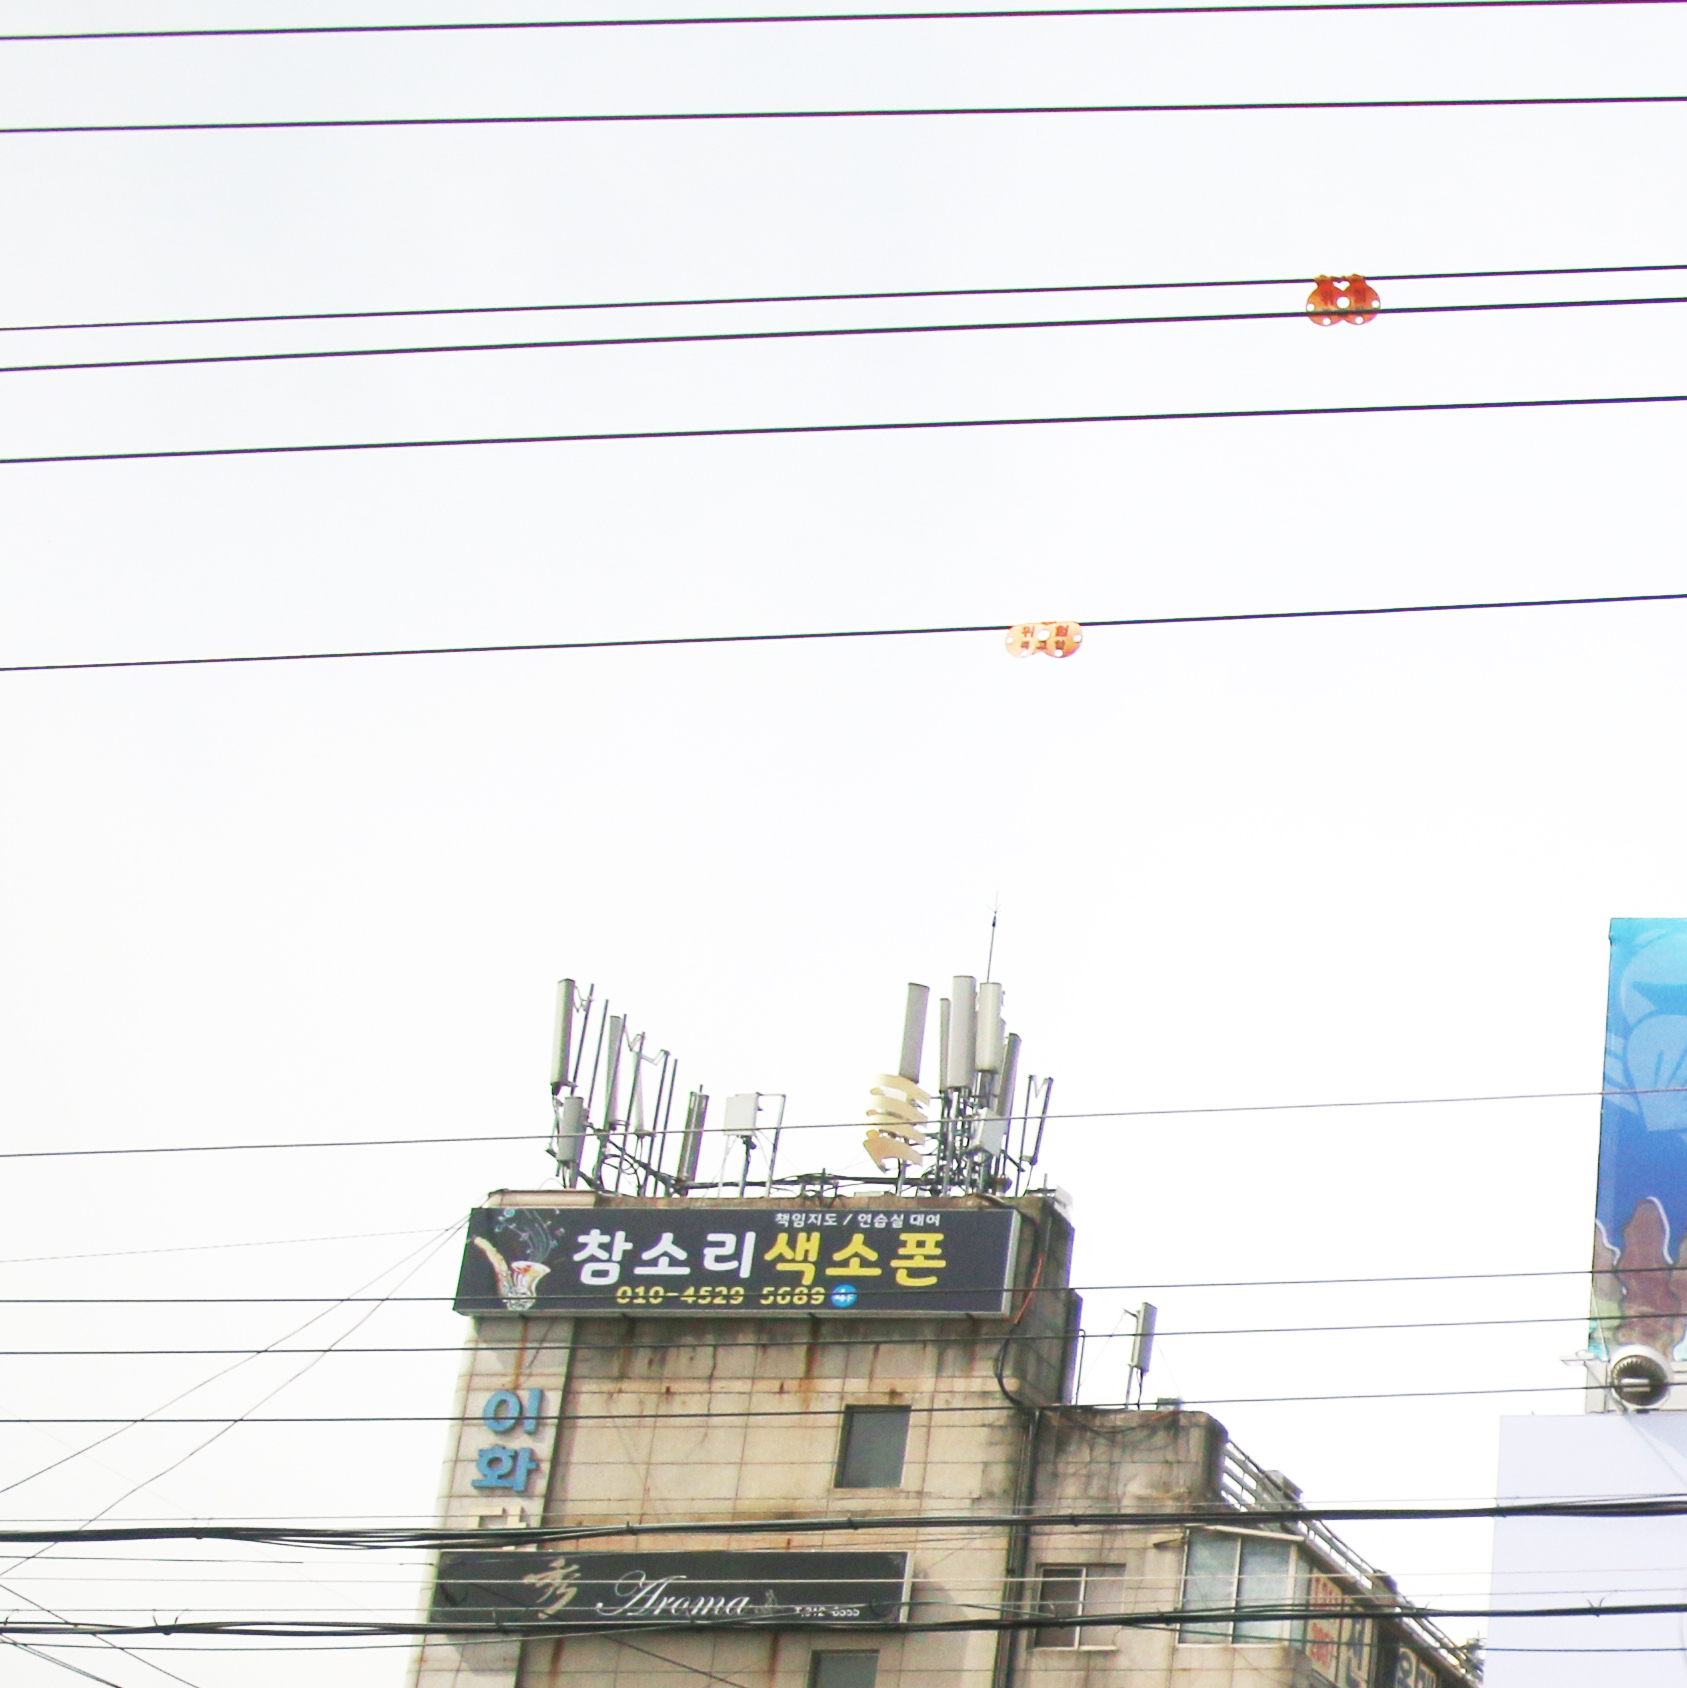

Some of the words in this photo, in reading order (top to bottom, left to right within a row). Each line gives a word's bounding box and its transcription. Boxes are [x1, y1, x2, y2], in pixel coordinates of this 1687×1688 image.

[775, 1212, 838, 1229] 책임지도
[857, 1212, 905, 1229] 연습실
[909, 1213, 941, 1227] 대여
[573, 1229, 756, 1285] 참소리
[764, 1231, 946, 1287] 색소폰
[596, 1569, 750, 1617] Aroma
